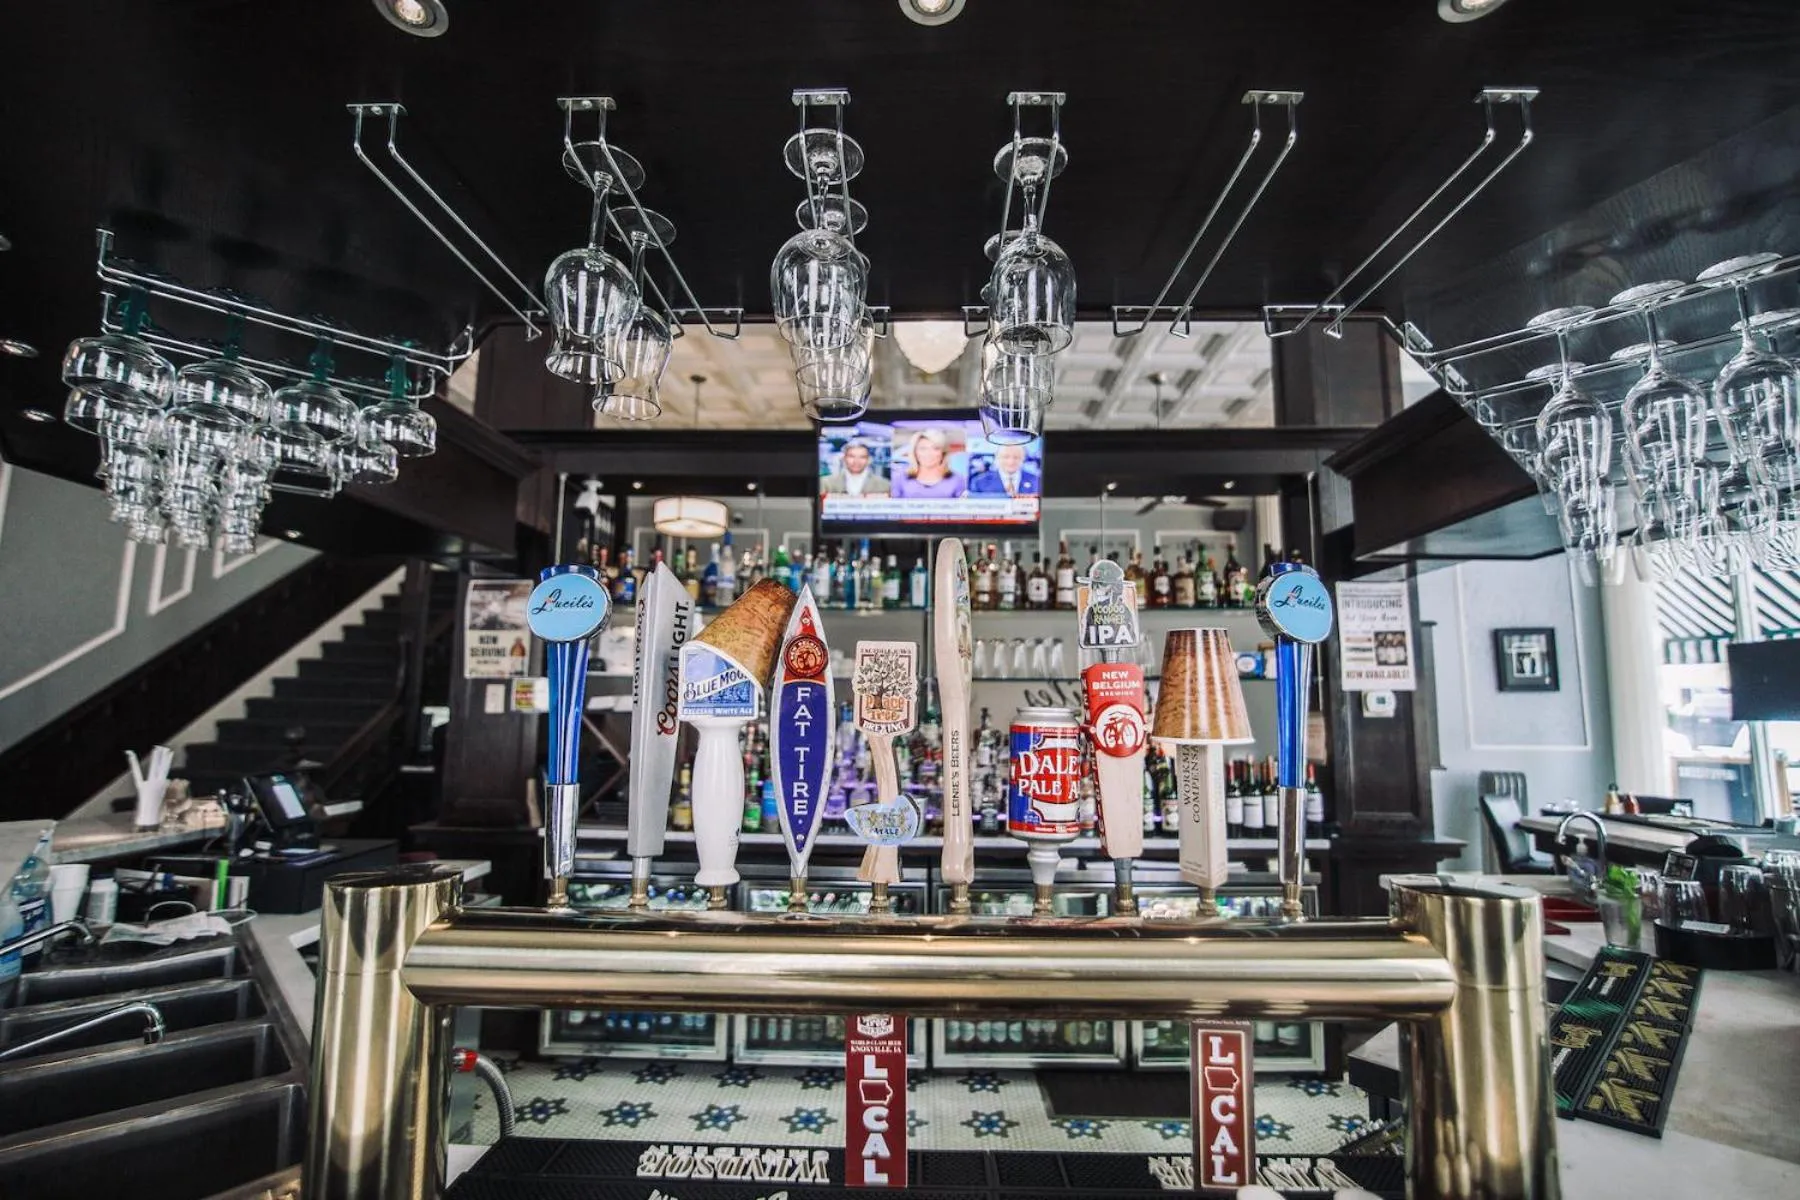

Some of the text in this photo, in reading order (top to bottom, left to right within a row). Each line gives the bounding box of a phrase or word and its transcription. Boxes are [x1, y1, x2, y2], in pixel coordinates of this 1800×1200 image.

[1088, 624, 1134, 645] IPA
[683, 669, 748, 701] BLUE MOO
[1091, 681, 1141, 690] BELGIUM
[1102, 671, 1129, 680] NEW
[793, 687, 813, 737] FAT
[951, 729, 960, 768] BEERS
[1018, 750, 1081, 777] DALE
[792, 747, 811, 816] TIRE
[1018, 778, 1063, 797] PALE
